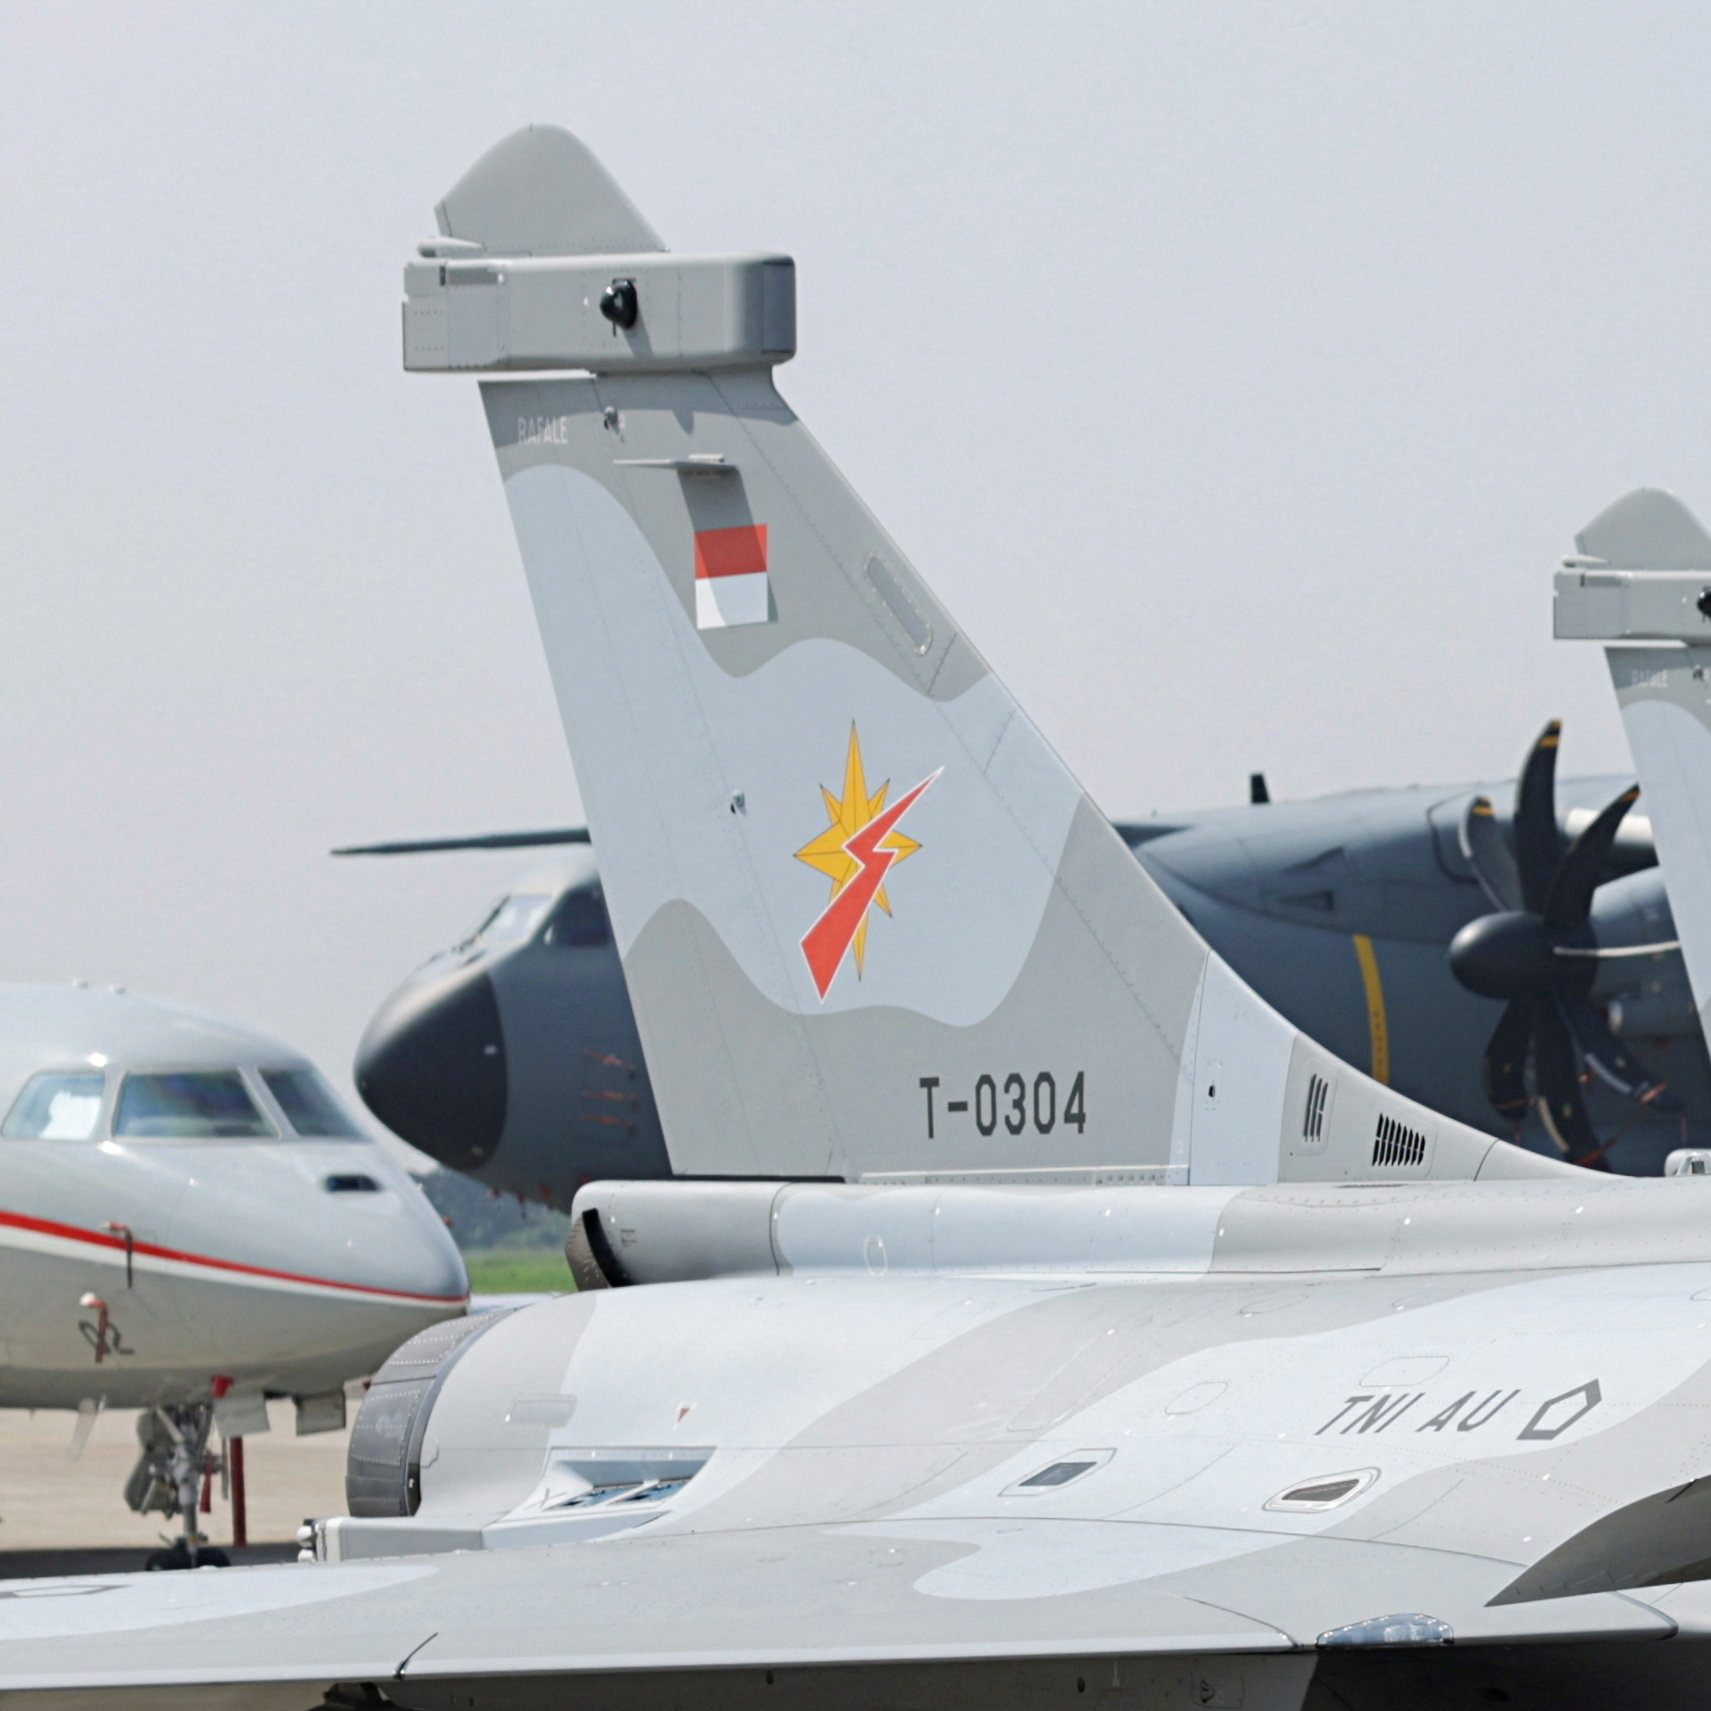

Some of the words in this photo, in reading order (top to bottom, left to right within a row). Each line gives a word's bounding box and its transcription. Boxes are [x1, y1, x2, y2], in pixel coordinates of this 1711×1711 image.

[517, 416, 568, 444] RAFALE
[919, 1071, 1086, 1139] T-0304
[1314, 1392, 1426, 1436] TNI
[1415, 1389, 1522, 1433] AU
